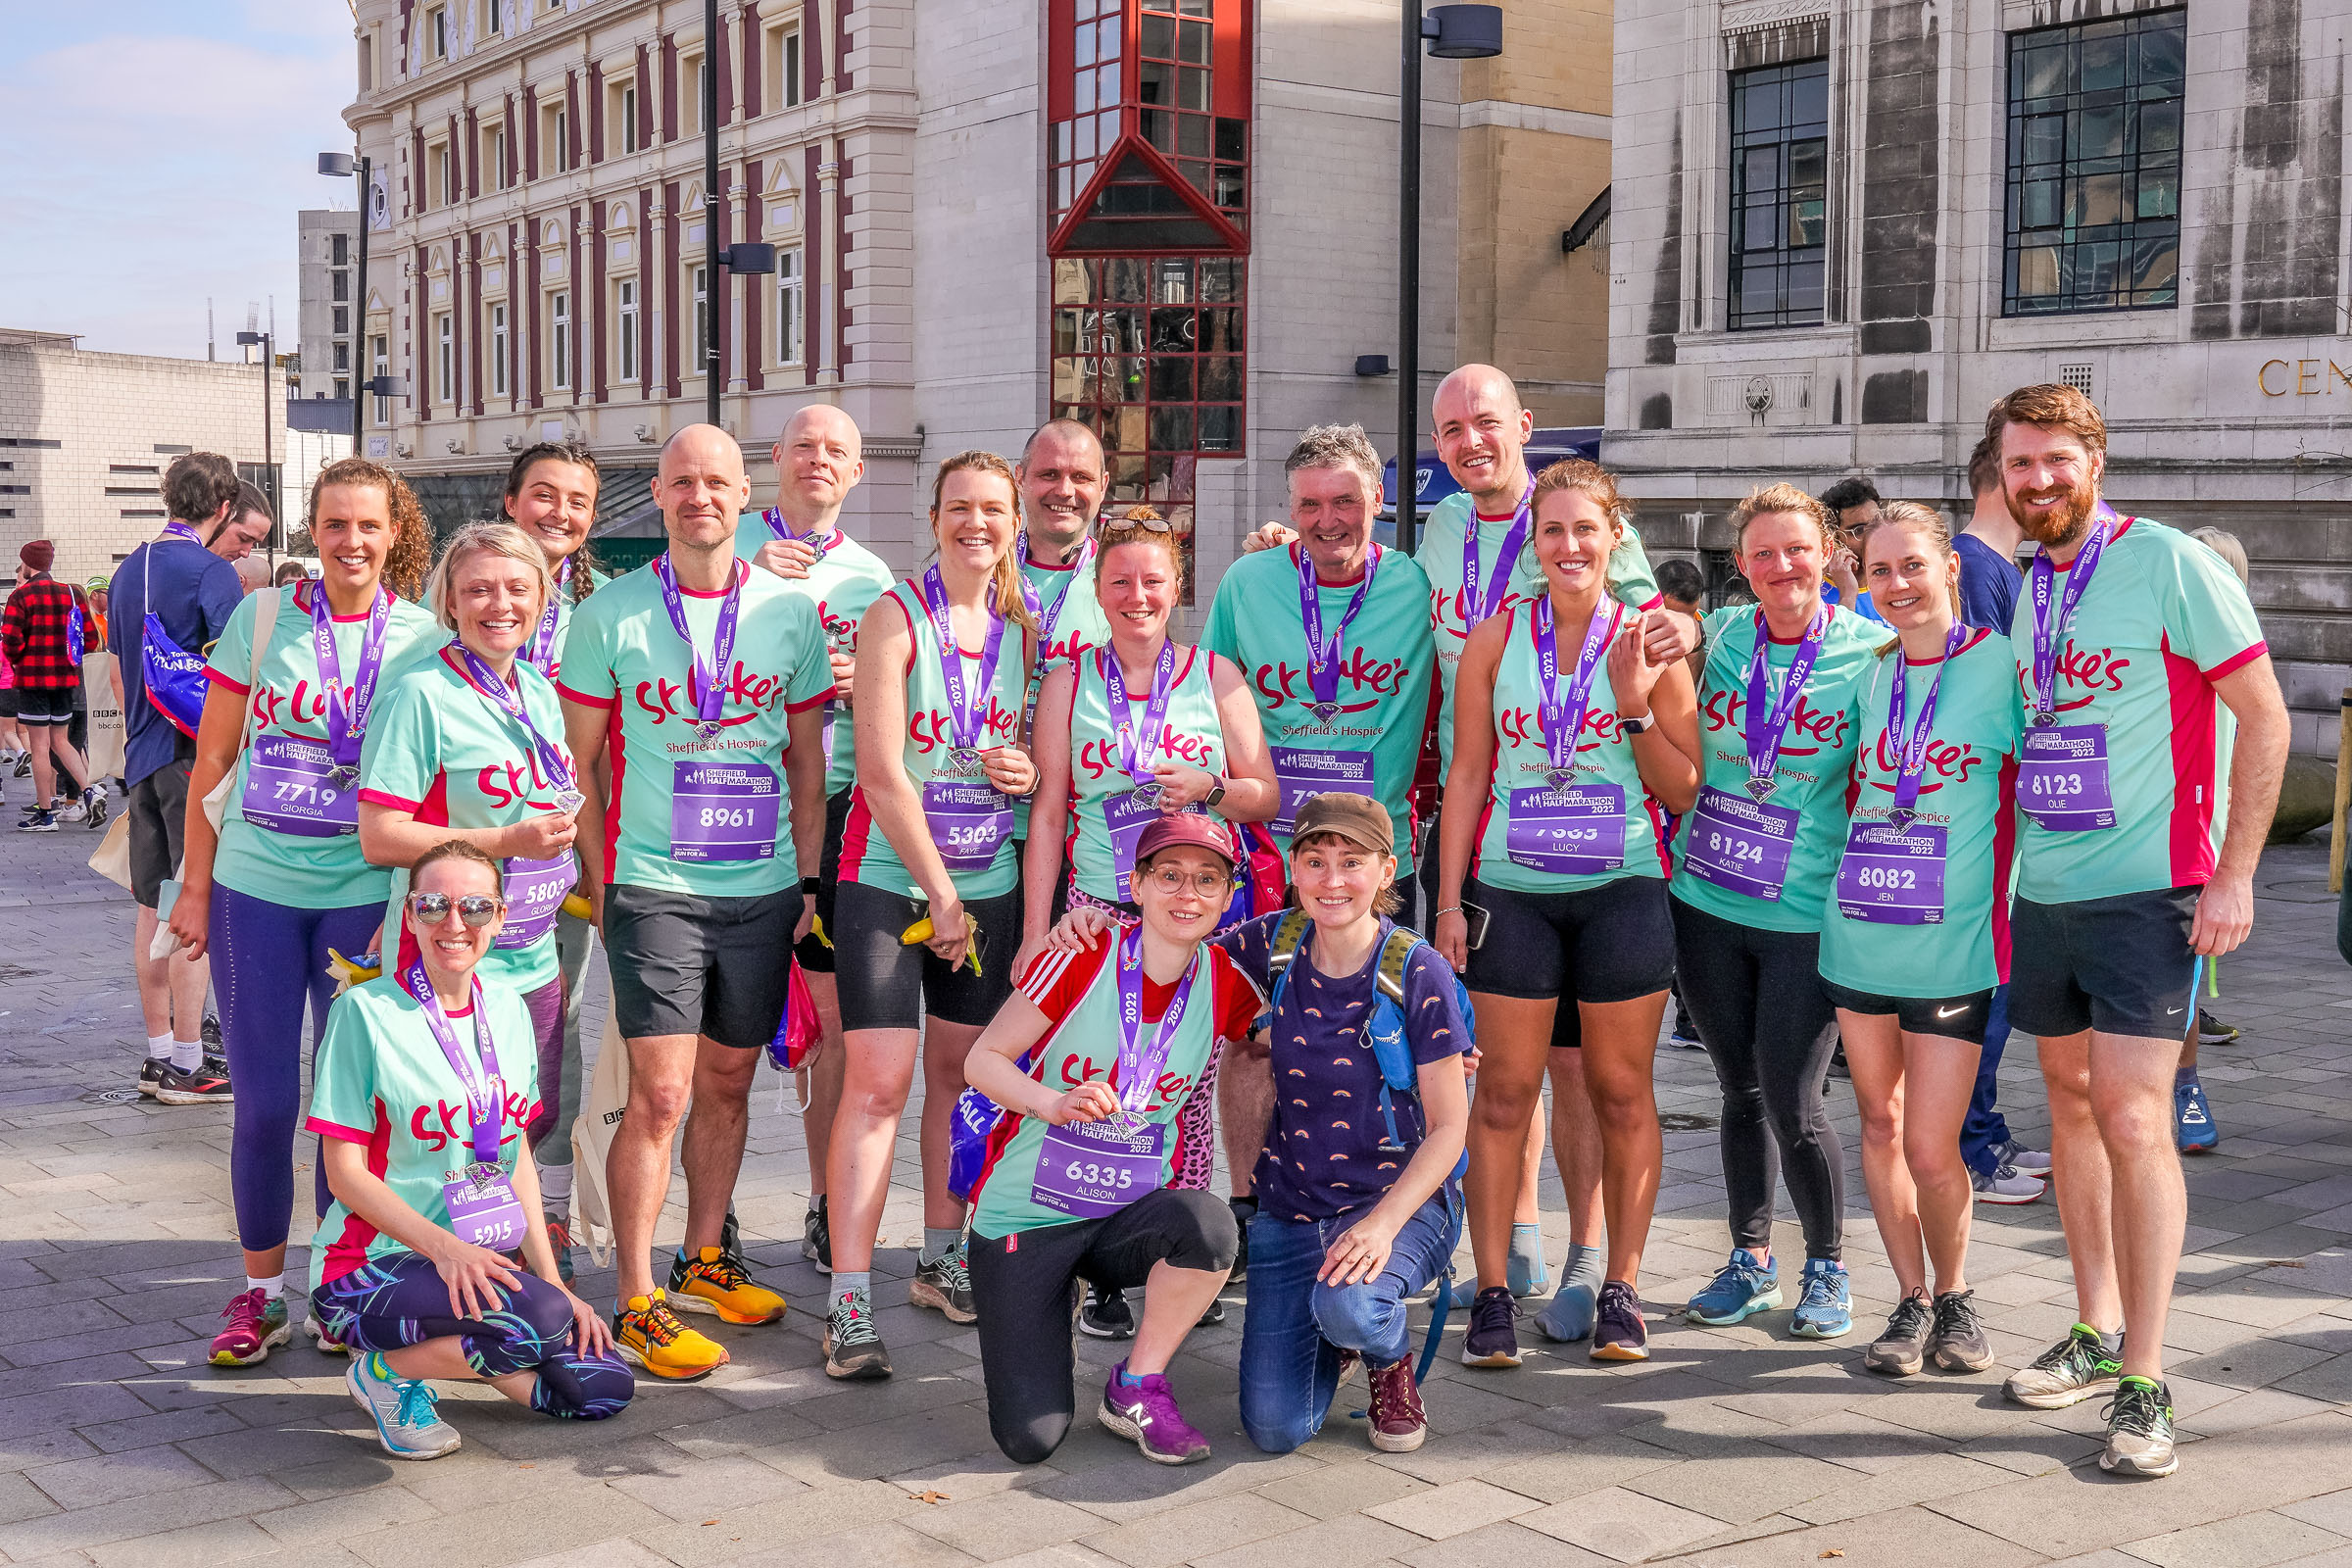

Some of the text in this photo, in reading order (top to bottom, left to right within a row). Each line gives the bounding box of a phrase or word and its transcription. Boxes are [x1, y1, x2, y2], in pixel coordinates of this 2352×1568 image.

[2036, 575, 2048, 607] 2022
[543, 605, 555, 632] 2022
[318, 628, 332, 659] 2022
[1585, 635, 1600, 663] 2022
[1160, 648, 1173, 674] 2022
[1544, 650, 1554, 680] 2022
[1788, 660, 1809, 688] 2022
[950, 675, 963, 708] 2022
[1109, 676, 1123, 706] 2022
[1255, 662, 1300, 710] St
[636, 677, 681, 724] St
[92, 710, 118, 718] BBC
[1704, 690, 1746, 732] St
[909, 709, 950, 754] St
[1282, 724, 1384, 739] Sheffield's Hospice
[1500, 707, 1532, 748] St
[287, 743, 327, 757] SHEFFIELD
[727, 738, 768, 751] Hospice
[2047, 739, 2094, 750] MARATHON
[2071, 748, 2095, 758] 2022
[286, 751, 334, 765] HALF MARA
[1080, 738, 1117, 780] St
[1298, 754, 1335, 762] SHEFFIELD
[1298, 760, 1318, 769] HALF
[707, 769, 746, 778] SHEFFIELD
[1343, 770, 1364, 779] 2022
[1776, 765, 1820, 783] Hospice
[753, 785, 772, 794] 2022
[2032, 773, 2083, 795] 8123
[249, 781, 337, 807] M 7719
[1564, 797, 1615, 807] MARATHON
[2047, 799, 2067, 808] OLIE
[280, 804, 323, 816] GIORGIA
[1721, 797, 1758, 812] SHEFFIELD
[700, 808, 755, 827] 8961
[1720, 806, 1787, 828] HALF MARATHON
[947, 825, 998, 846] 5303
[1762, 824, 1785, 836] 2022
[1552, 843, 1581, 853] LUCY
[1691, 829, 1764, 864] M 8124
[1884, 837, 1935, 846] MARATHON
[1910, 846, 1934, 855] 2022
[959, 847, 981, 856] FAYE
[1719, 858, 1744, 872] KATIE
[1858, 866, 1916, 889] 8082
[1876, 893, 1894, 902] JEN
[413, 968, 432, 1001] 2022
[1125, 992, 1137, 1024] 2022
[1167, 997, 1185, 1027] 2022
[479, 1022, 492, 1054] 2022
[411, 1100, 463, 1152] St
[959, 1099, 986, 1135] ALL
[1081, 1129, 1153, 1145] HALF MARATHON
[1130, 1145, 1152, 1153] 2022
[1042, 1157, 1132, 1189] S 6335
[1048, 1197, 1059, 1205] FOR
[1076, 1185, 1116, 1200] ALISON
